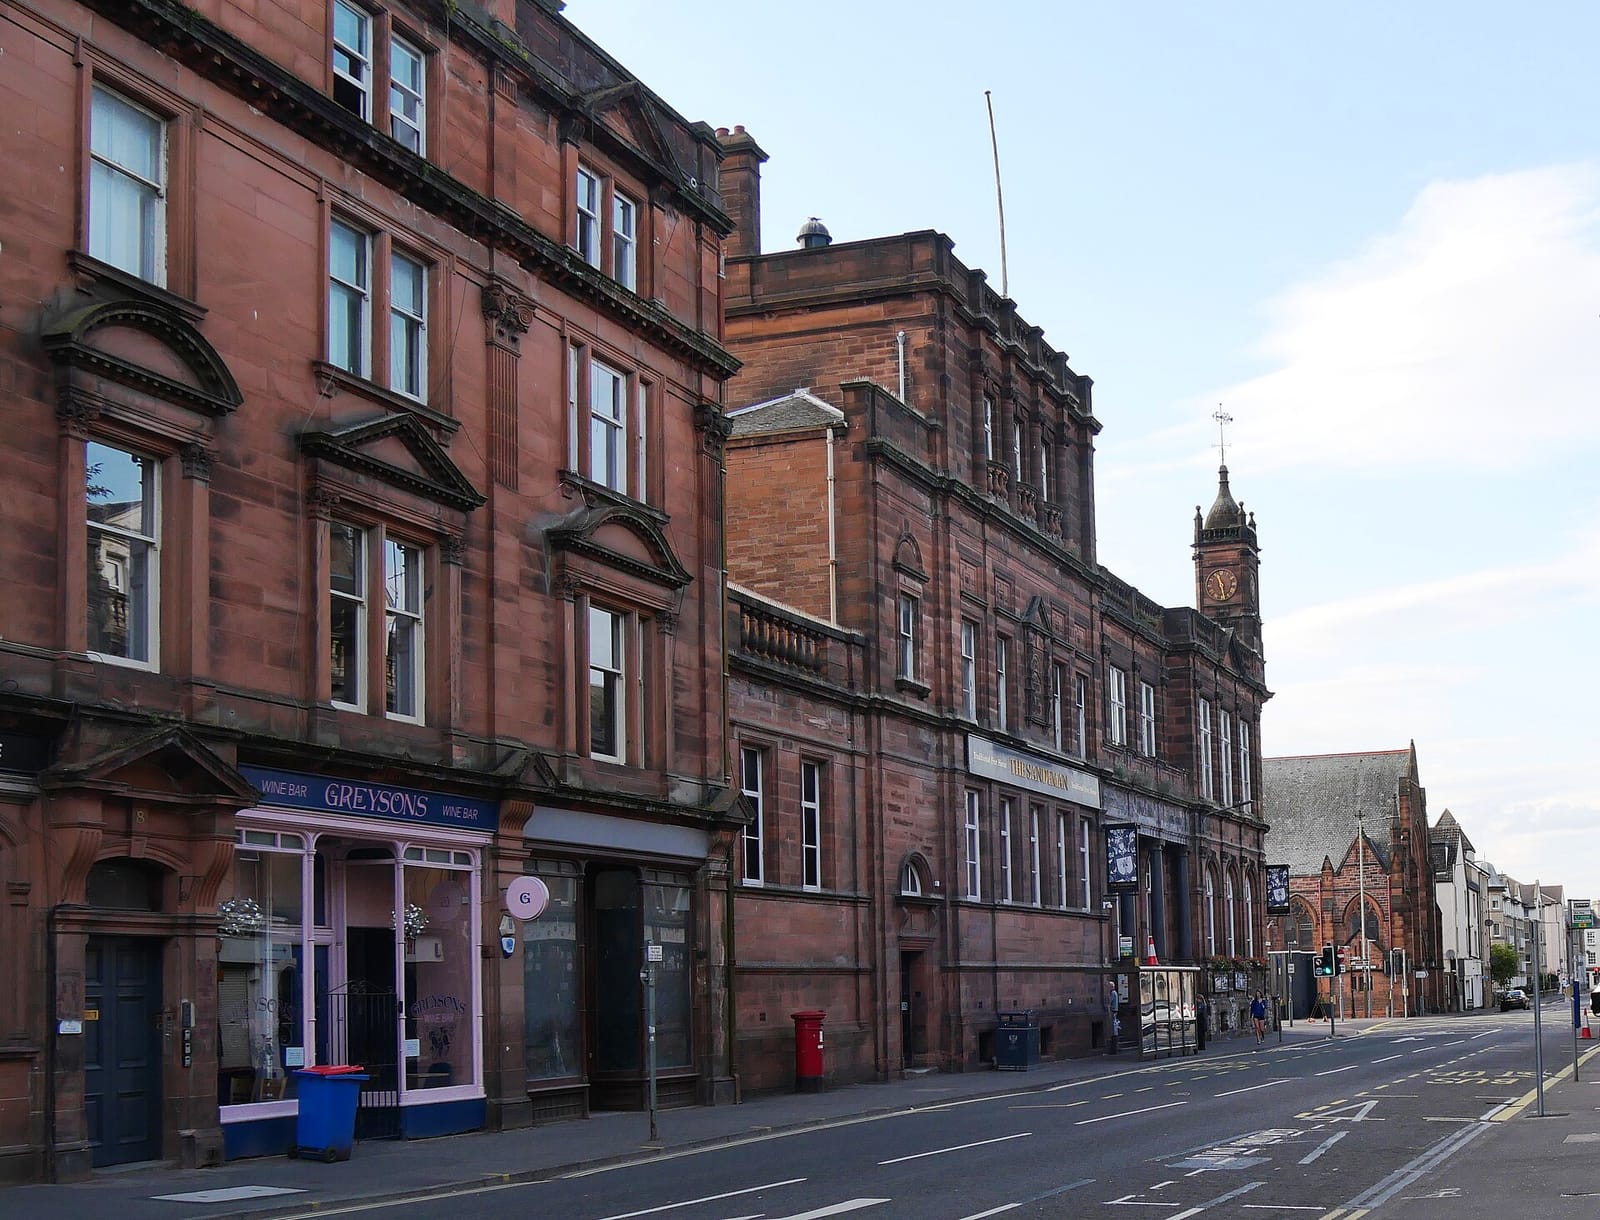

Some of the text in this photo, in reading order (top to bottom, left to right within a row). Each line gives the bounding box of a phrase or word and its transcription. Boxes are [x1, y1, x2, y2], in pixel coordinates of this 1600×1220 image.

[1010, 759, 1026, 778] THE
[261, 780, 308, 798] WINE BAR
[325, 783, 428, 817] GREYSONS
[442, 805, 479, 820] WINE BAR
[519, 892, 531, 904] G
